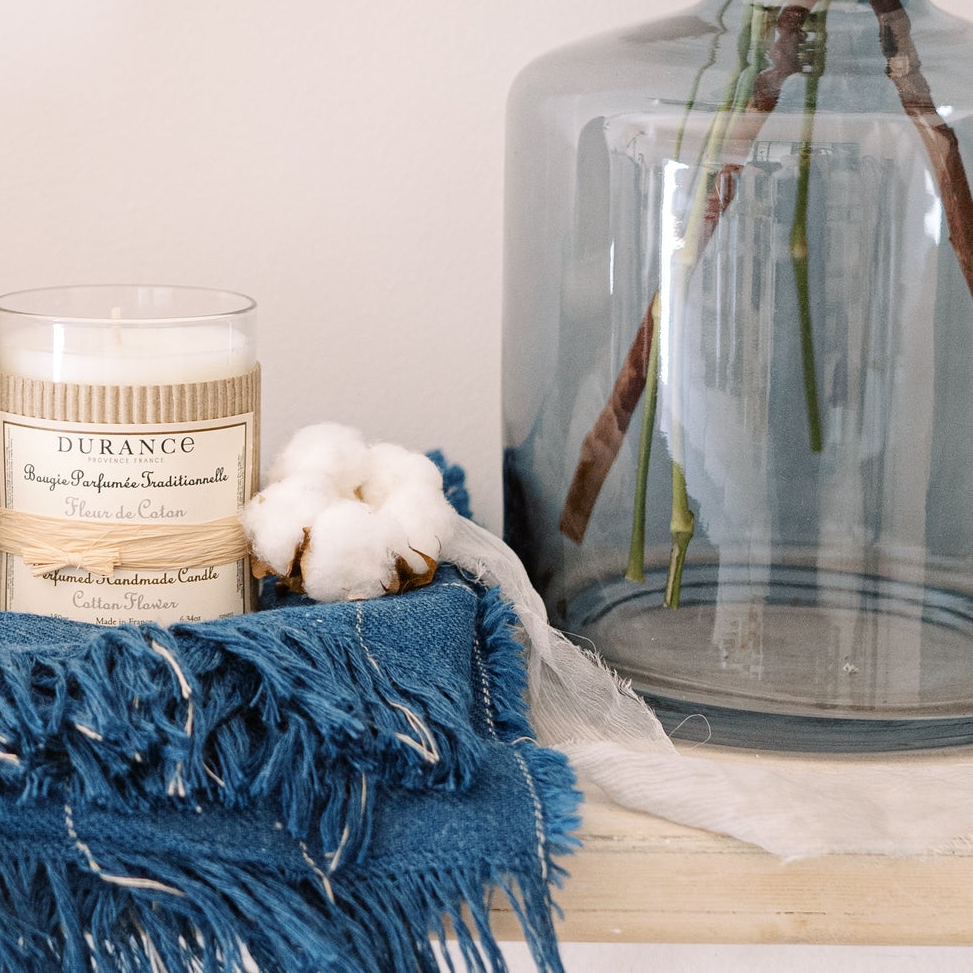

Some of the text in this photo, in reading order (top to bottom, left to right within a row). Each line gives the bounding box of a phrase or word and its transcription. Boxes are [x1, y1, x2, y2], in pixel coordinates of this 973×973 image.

[23, 463, 229, 493] Bougie Parfumée Traditionnelle
[65, 496, 187, 519] Fleur de Coton
[40, 568, 94, 587] erfumed
[178, 566, 220, 584] Candle
[72, 590, 179, 611] Cotton Flower
[96, 617, 117, 625] Made
